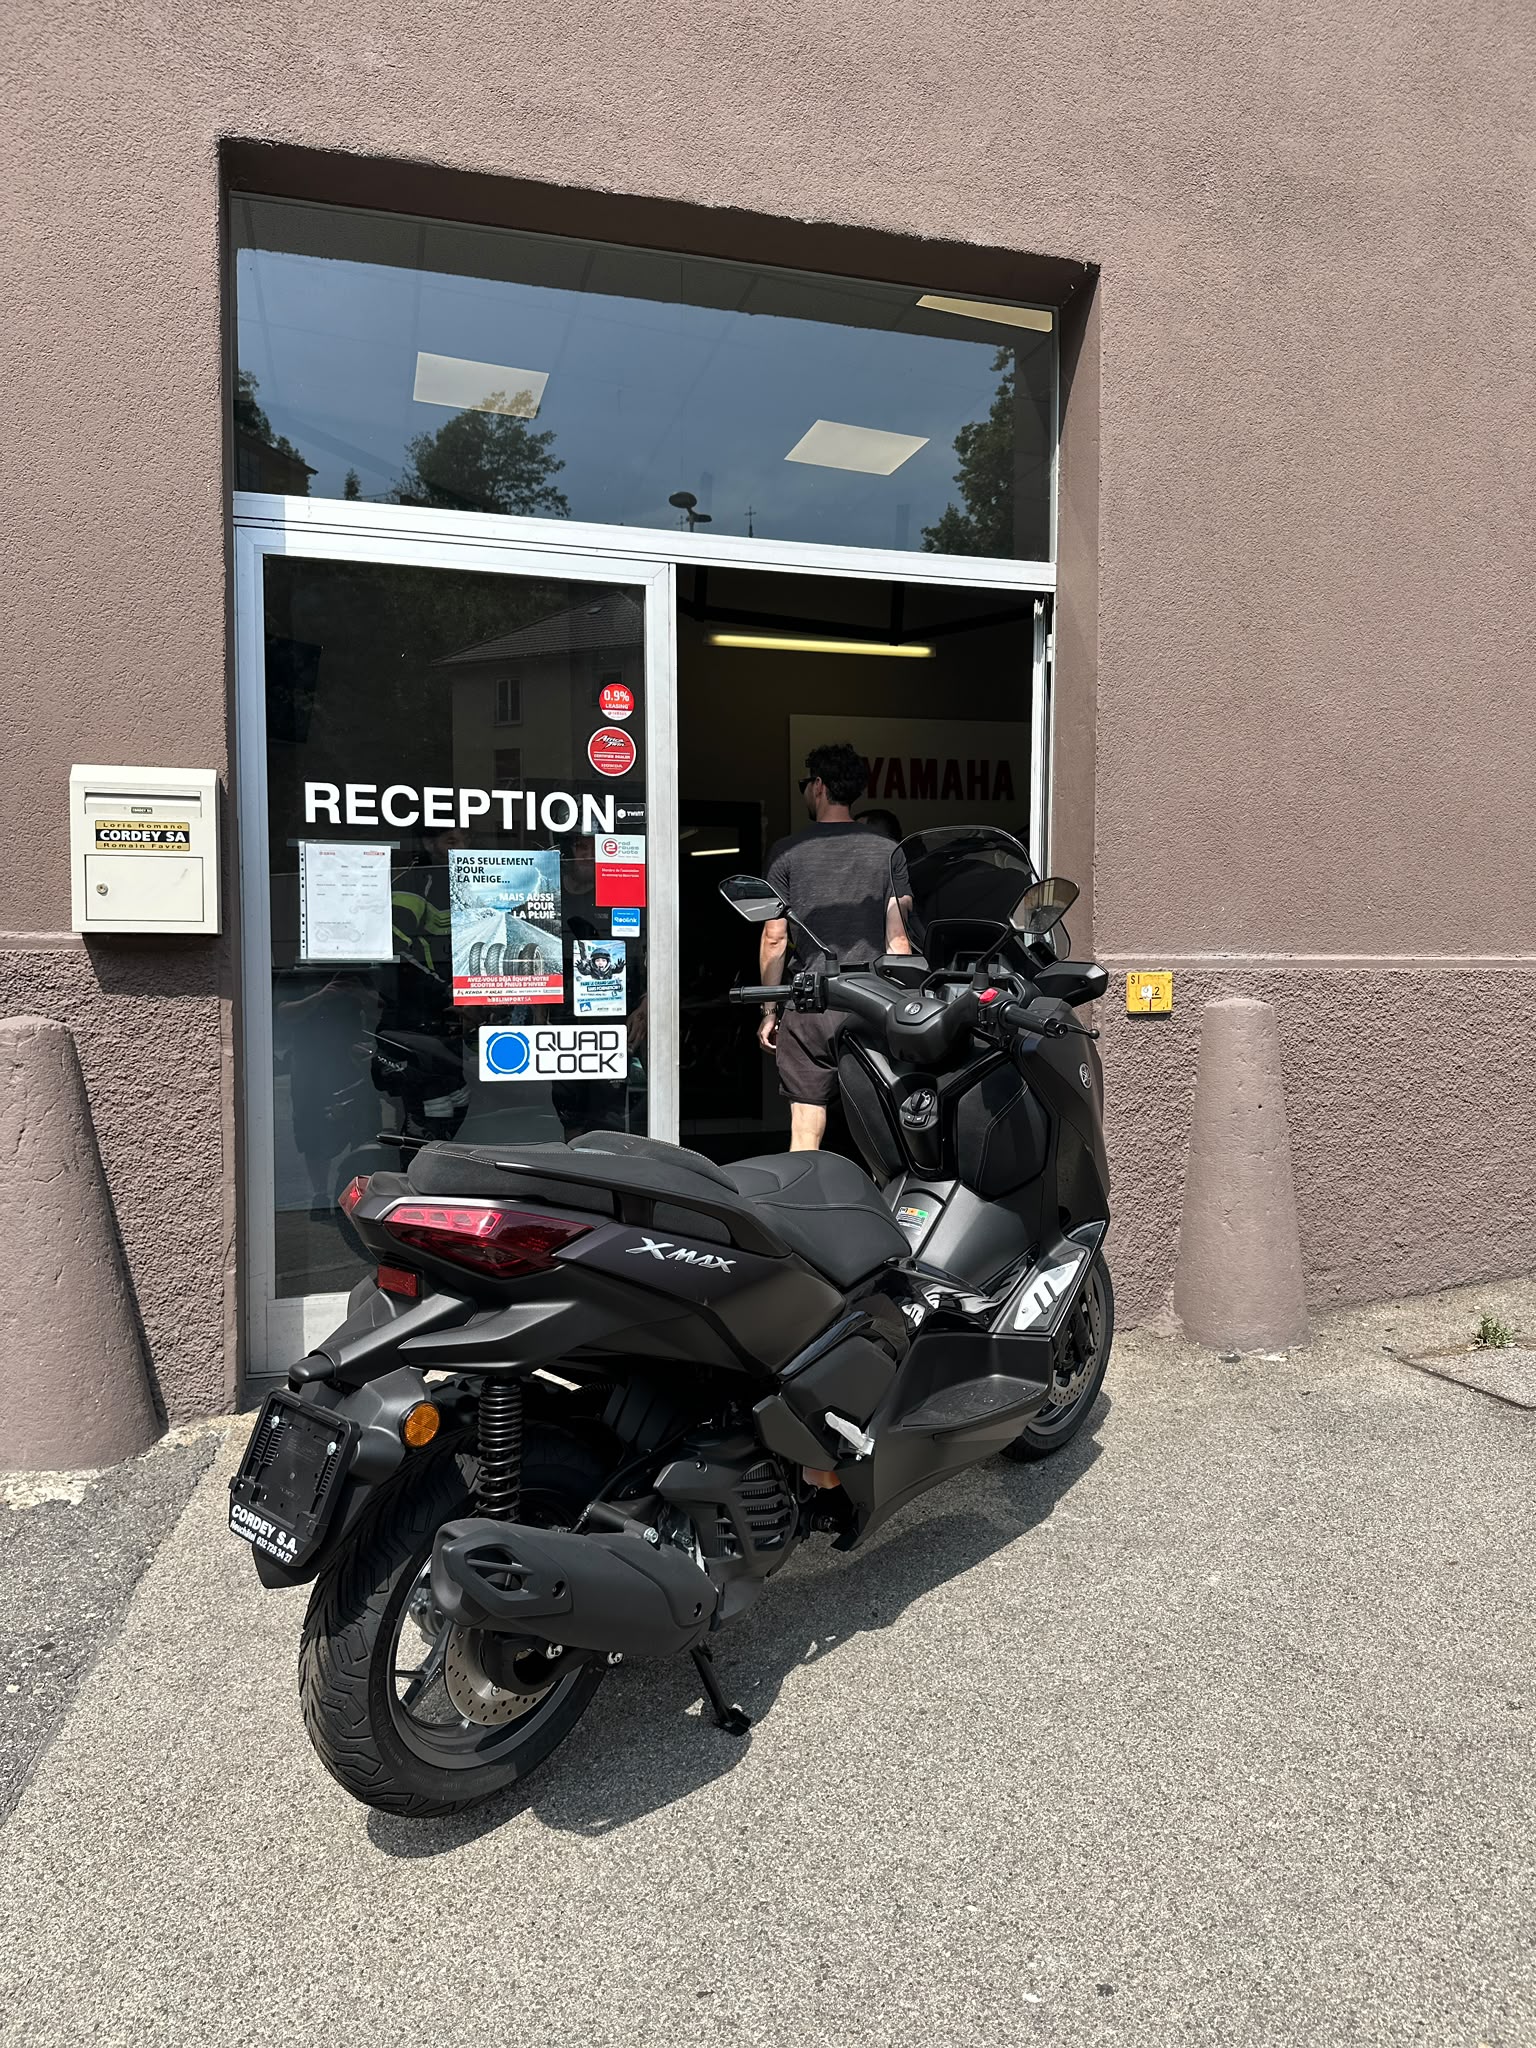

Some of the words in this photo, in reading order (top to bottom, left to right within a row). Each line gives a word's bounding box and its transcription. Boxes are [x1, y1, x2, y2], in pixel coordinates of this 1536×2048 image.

[604, 690, 630, 702] 0.9%
[595, 734, 624, 743] Africa
[605, 741, 625, 749] Twin
[862, 757, 1015, 801] YAMAHA
[304, 781, 615, 834] RECEPTION
[99, 830, 162, 842] CORDEY
[165, 831, 187, 843] SA
[456, 857, 476, 865] PAS
[478, 857, 534, 866] SEULEMENT
[456, 866, 485, 874] POUR
[457, 875, 471, 883] LA
[473, 875, 511, 884] NEIGE...
[499, 893, 524, 901] MAIS
[526, 893, 554, 901] AUSSI
[527, 902, 555, 910] POUR
[513, 910, 526, 919] LA
[528, 910, 555, 919] PLUIE
[535, 1030, 619, 1052] QUAD
[535, 1053, 619, 1074] LOCK
[625, 1236, 737, 1274] XMAX
[231, 1504, 277, 1538] CORDEY
[276, 1530, 298, 1555] S.A.
[256, 1535, 268, 1549] 032
[266, 1541, 279, 1555] 725
[276, 1547, 286, 1560] 34
[283, 1552, 294, 1564] 27
